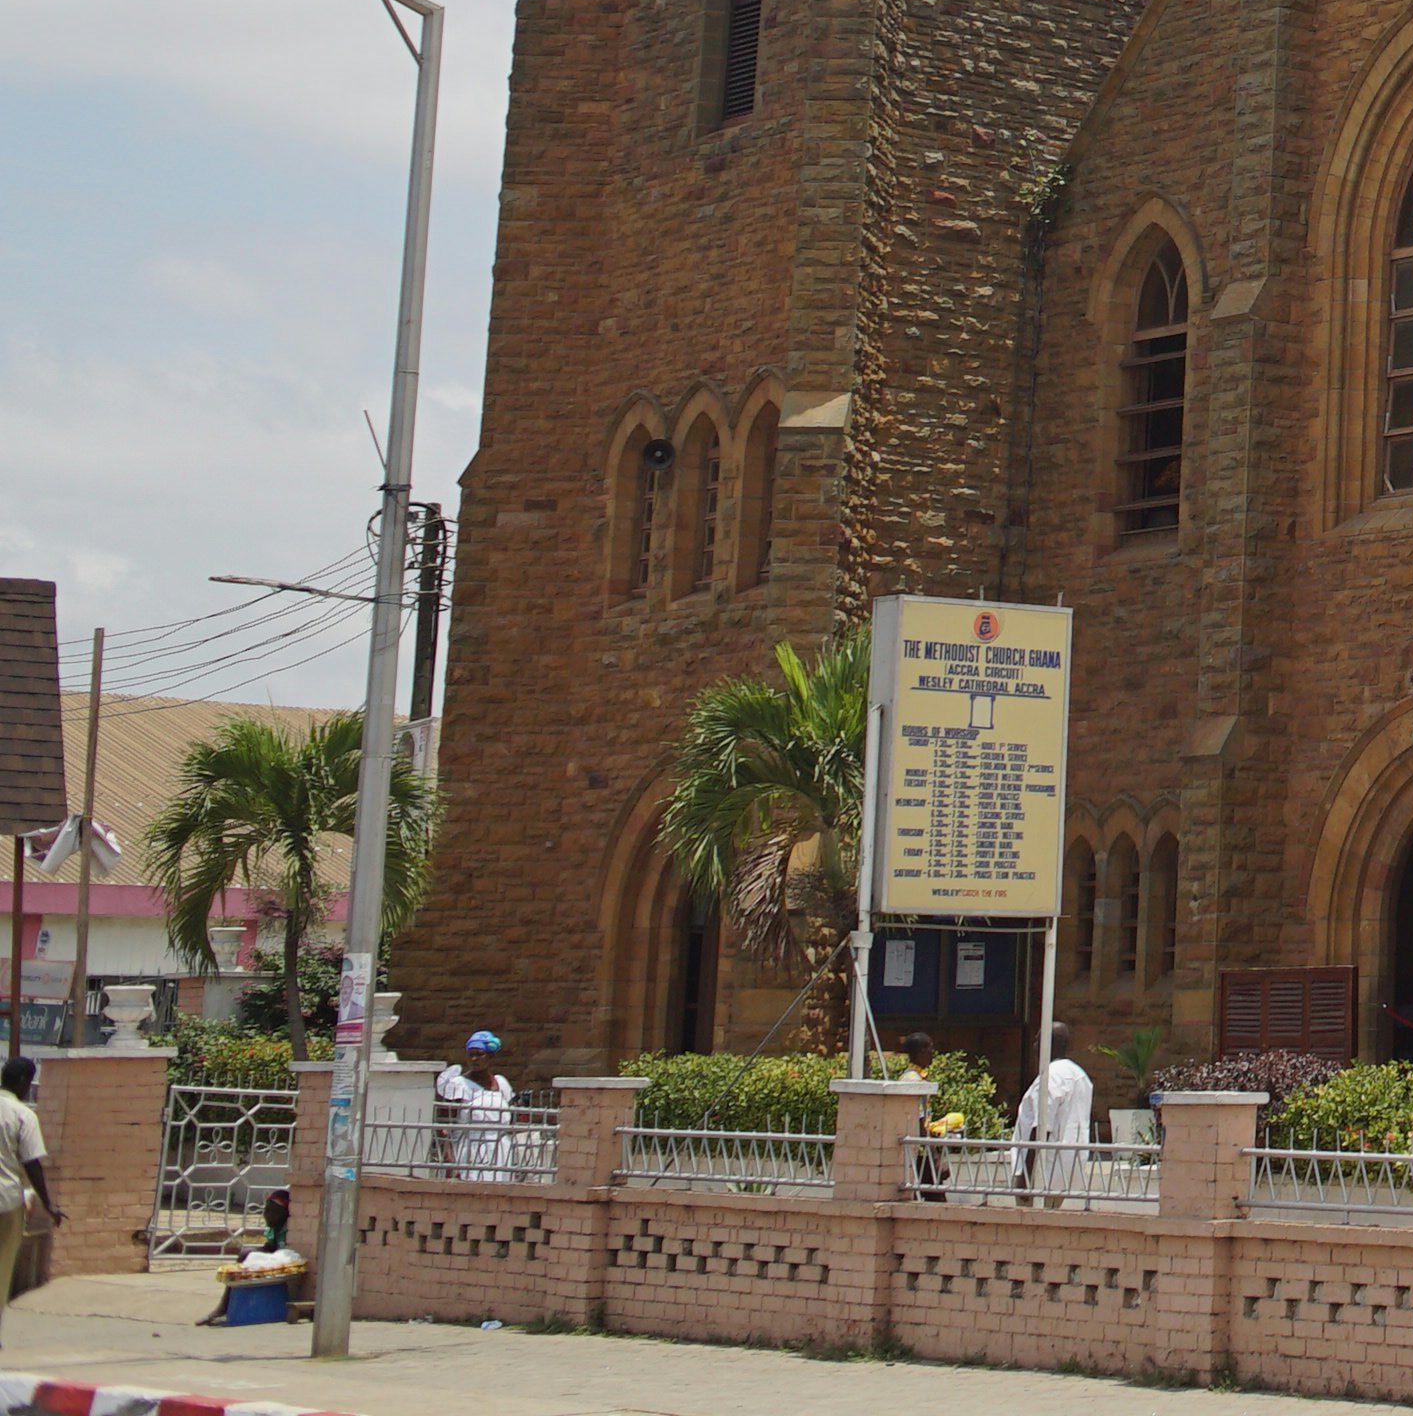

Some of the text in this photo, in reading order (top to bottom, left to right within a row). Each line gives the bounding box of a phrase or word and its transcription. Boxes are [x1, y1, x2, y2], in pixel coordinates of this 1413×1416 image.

[903, 639, 921, 659] THE
[924, 641, 981, 664] METHODIST
[1028, 649, 1061, 669] GHANA
[918, 675, 1046, 696] WESLEY CATHEDRAL ACCRA
[931, 726, 941, 737] OF
